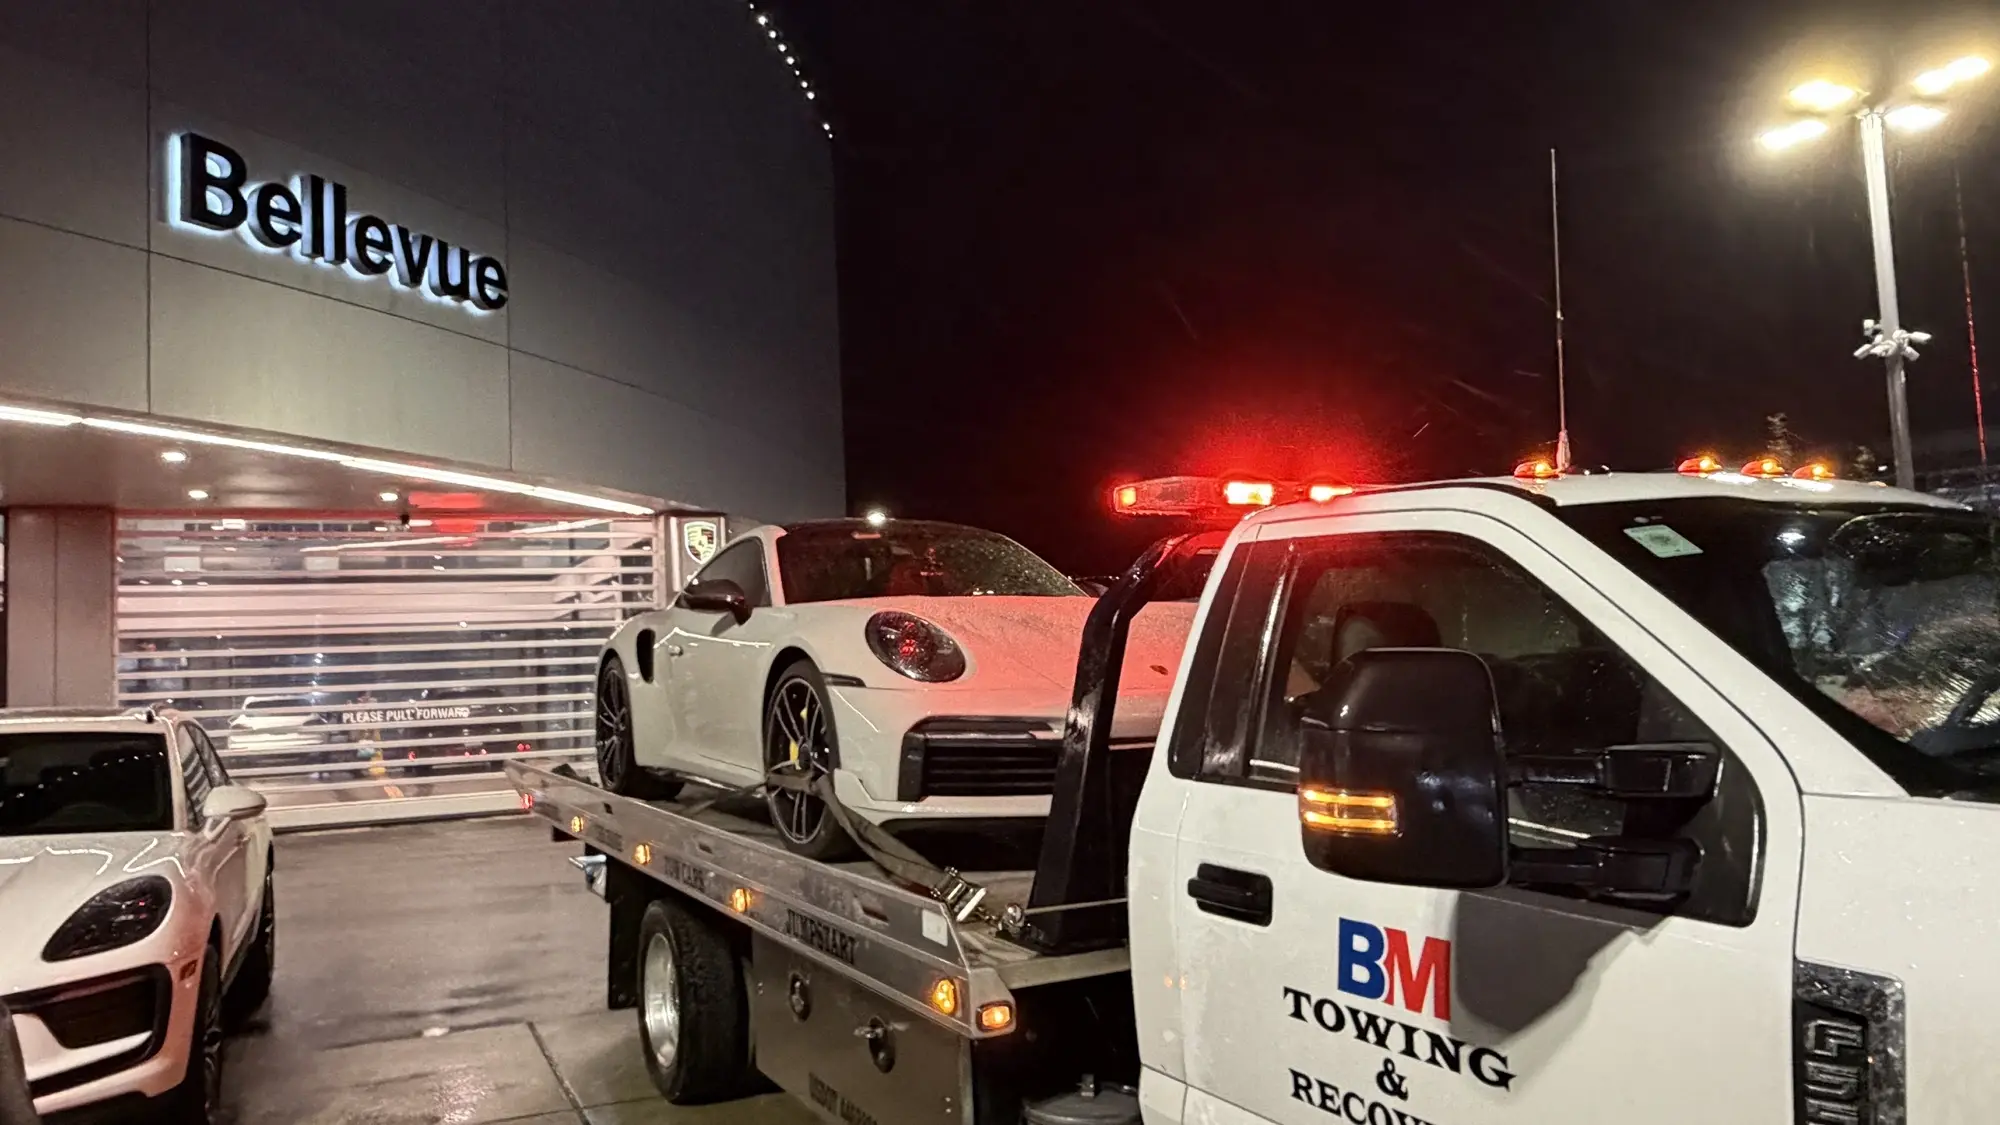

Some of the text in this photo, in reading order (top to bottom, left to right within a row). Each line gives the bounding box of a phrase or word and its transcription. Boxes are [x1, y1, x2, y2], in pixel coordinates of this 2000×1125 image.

[180, 132, 508, 311] Bellevue
[342, 710, 383, 724] PLEASE
[385, 708, 414, 721] PULL
[784, 908, 856, 965] JUMPSTART
[1337, 917, 1451, 1022] BM
[1283, 986, 1517, 1092] TOWING
[1376, 1057, 1409, 1101] &
